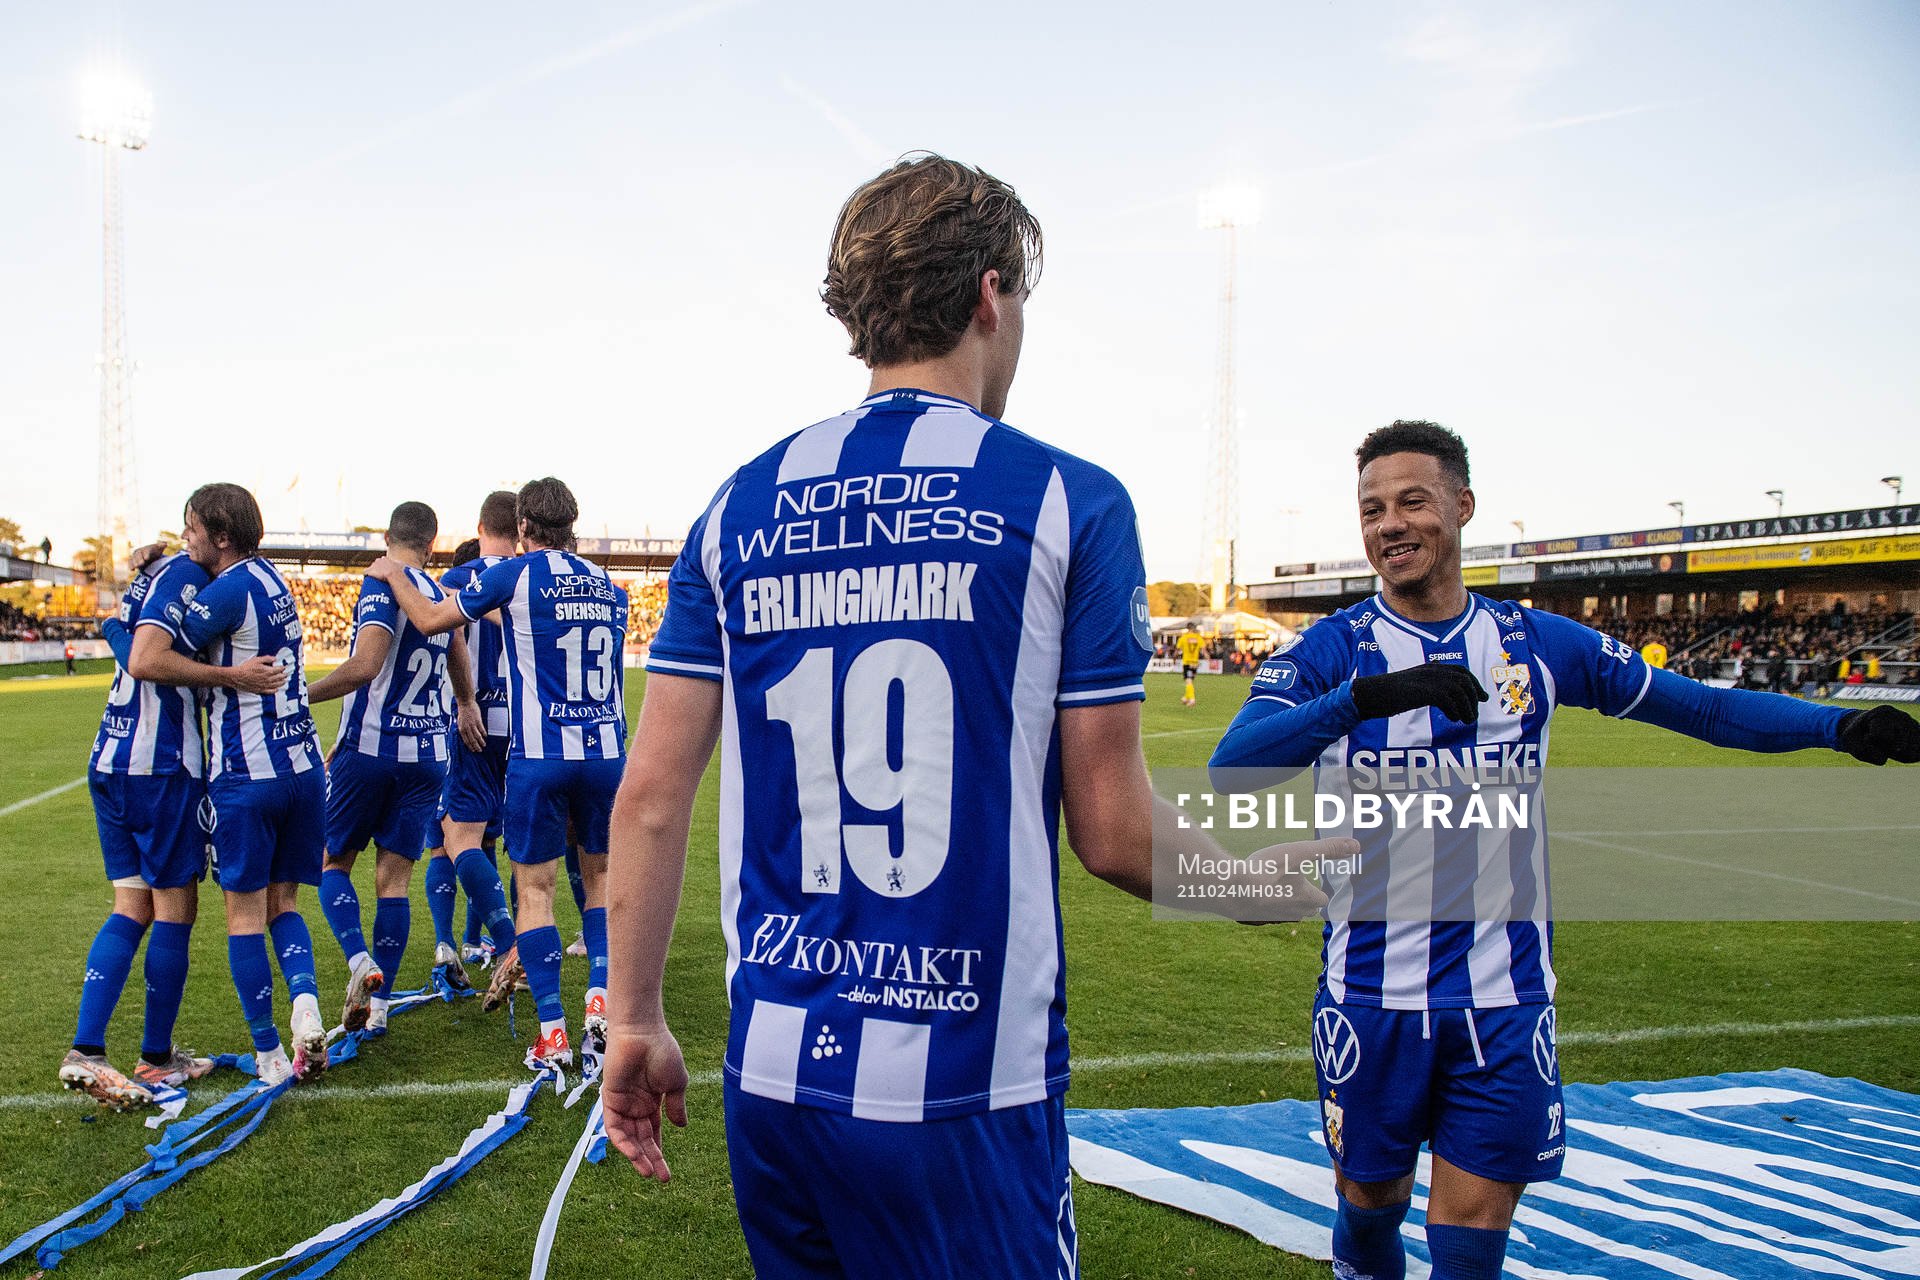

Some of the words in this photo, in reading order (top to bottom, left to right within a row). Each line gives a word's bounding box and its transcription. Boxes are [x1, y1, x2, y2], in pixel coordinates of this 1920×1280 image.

[773, 472, 960, 520] NORDIC
[737, 506, 1005, 562] WELLNESS
[540, 587, 617, 602] WELLNESS
[555, 575, 607, 590] NORDIC
[742, 561, 979, 635] ERLINGMARK
[554, 602, 612, 622] SVENSSON
[556, 625, 614, 701] 13
[1428, 652, 1463, 662] SERNEKE
[764, 637, 955, 899] 19
[1351, 743, 1541, 791] SERNEKE
[882, 985, 980, 1012] INSTALCO
[1547, 1102, 1562, 1140] 22
[1537, 1145, 1562, 1161] CRAFT
